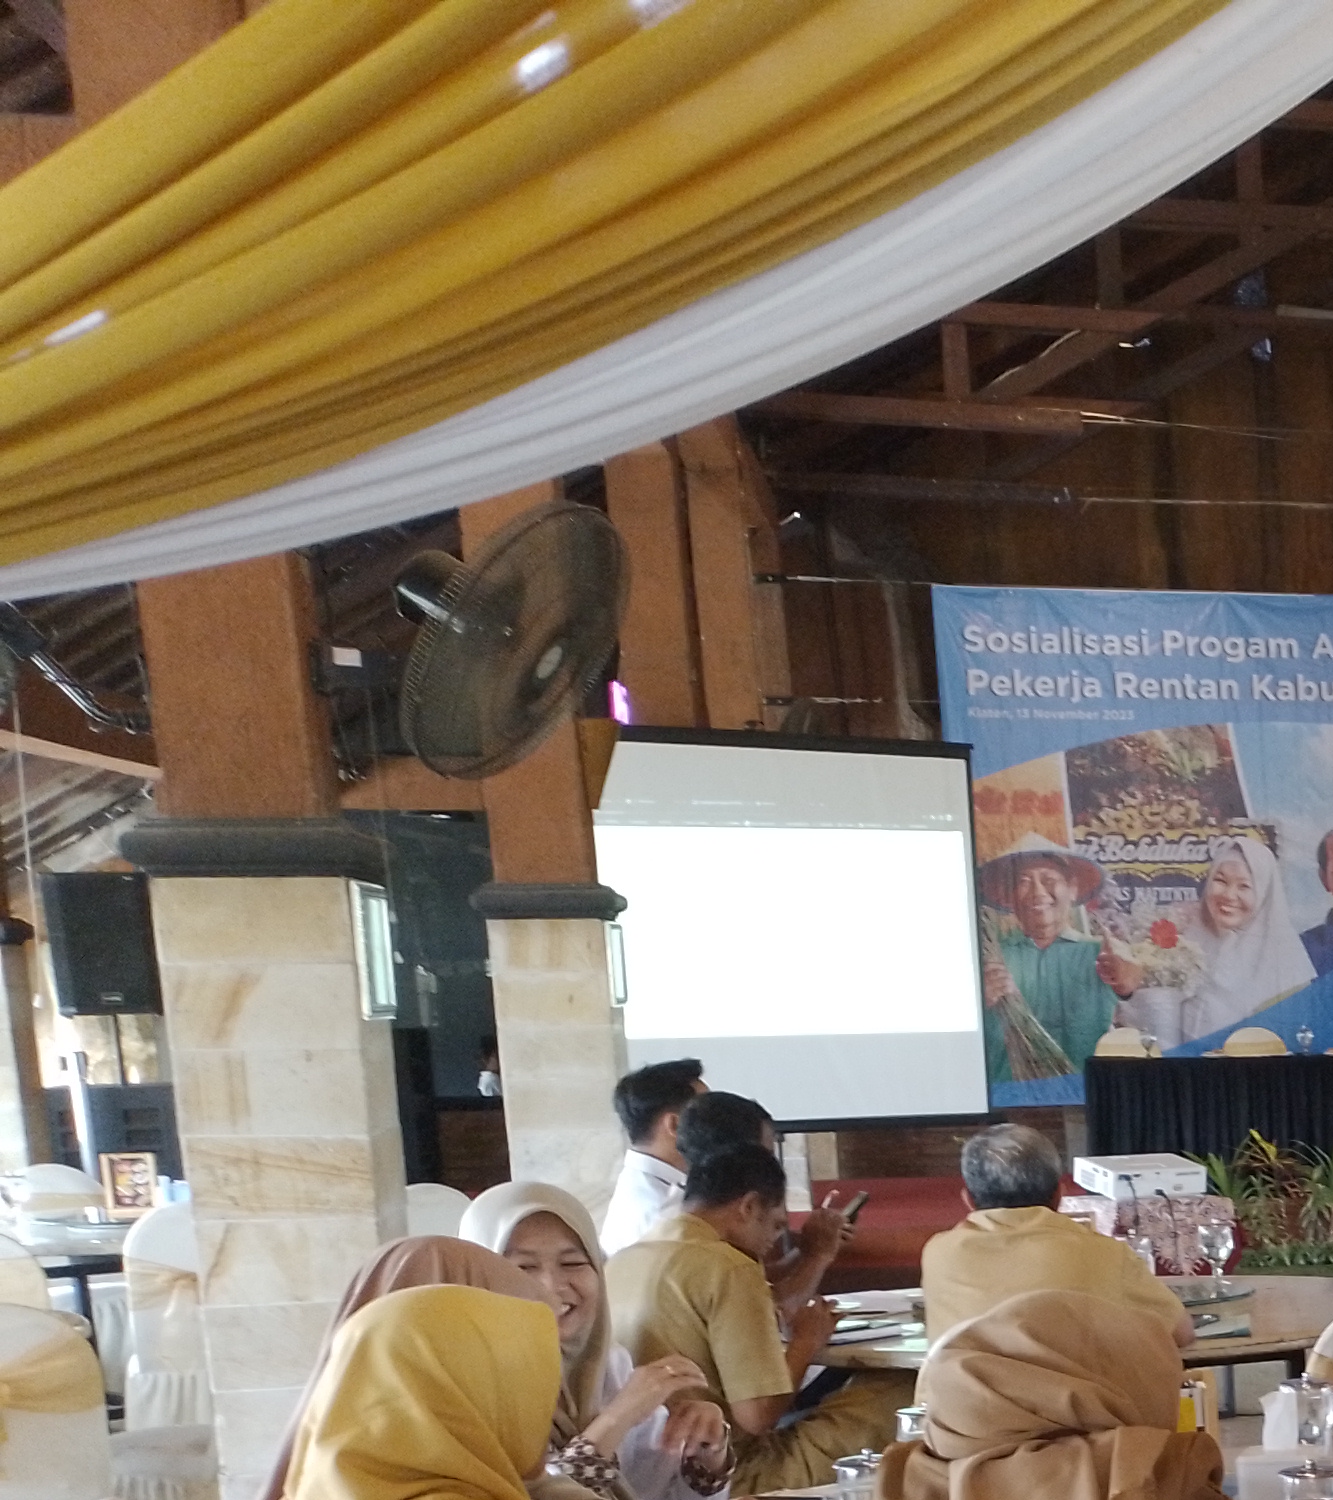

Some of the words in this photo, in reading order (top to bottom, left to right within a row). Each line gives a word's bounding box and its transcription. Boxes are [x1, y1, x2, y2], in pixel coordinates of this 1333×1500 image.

[962, 624, 1152, 656] Sosialisasi
[1162, 629, 1298, 663] Progam
[966, 668, 1103, 703] Pekerja
[1114, 671, 1240, 701] Rentan
[967, 706, 1014, 720] Klaten,
[1032, 708, 1100, 720] November
